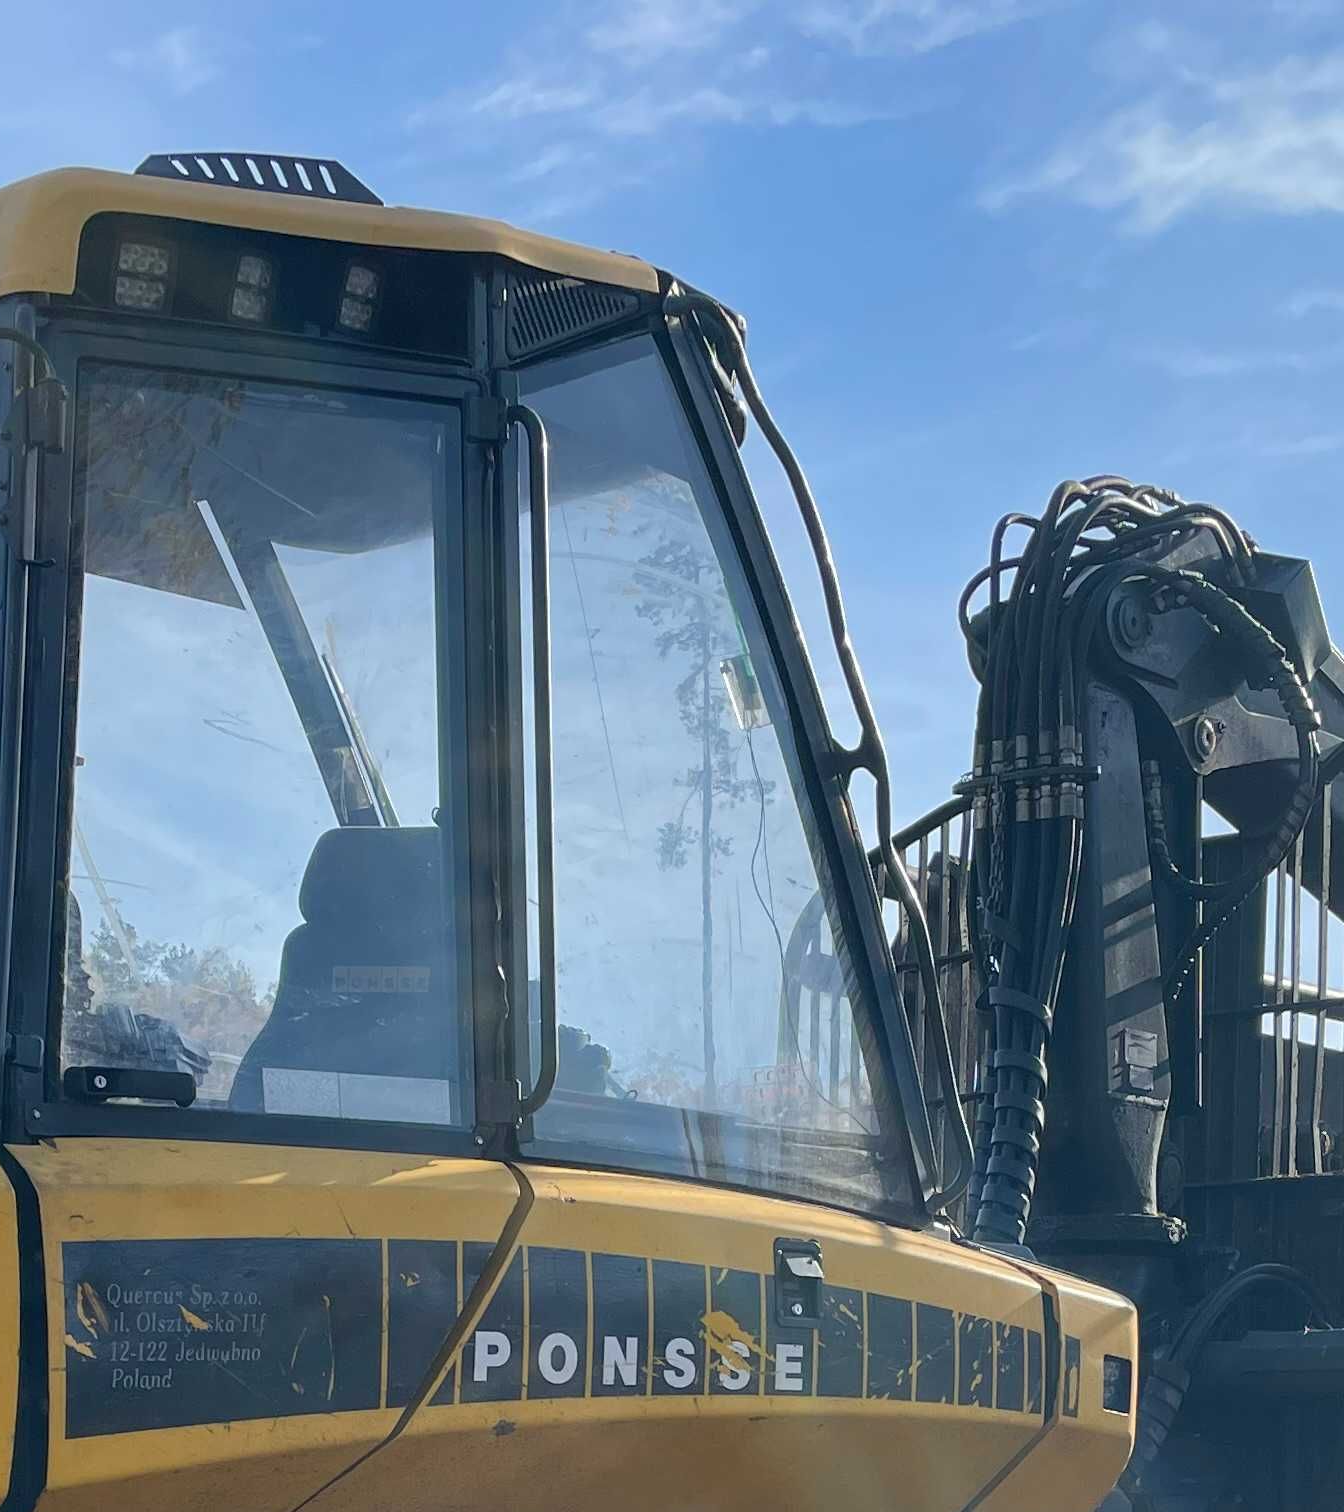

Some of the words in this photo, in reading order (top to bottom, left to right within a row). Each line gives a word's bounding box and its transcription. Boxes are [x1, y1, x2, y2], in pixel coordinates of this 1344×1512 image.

[136, 1312, 235, 1337] Olsztyska
[110, 1341, 168, 1362] 12-122
[473, 1330, 804, 1391] PONSSE
[112, 1368, 173, 1390] Poland
